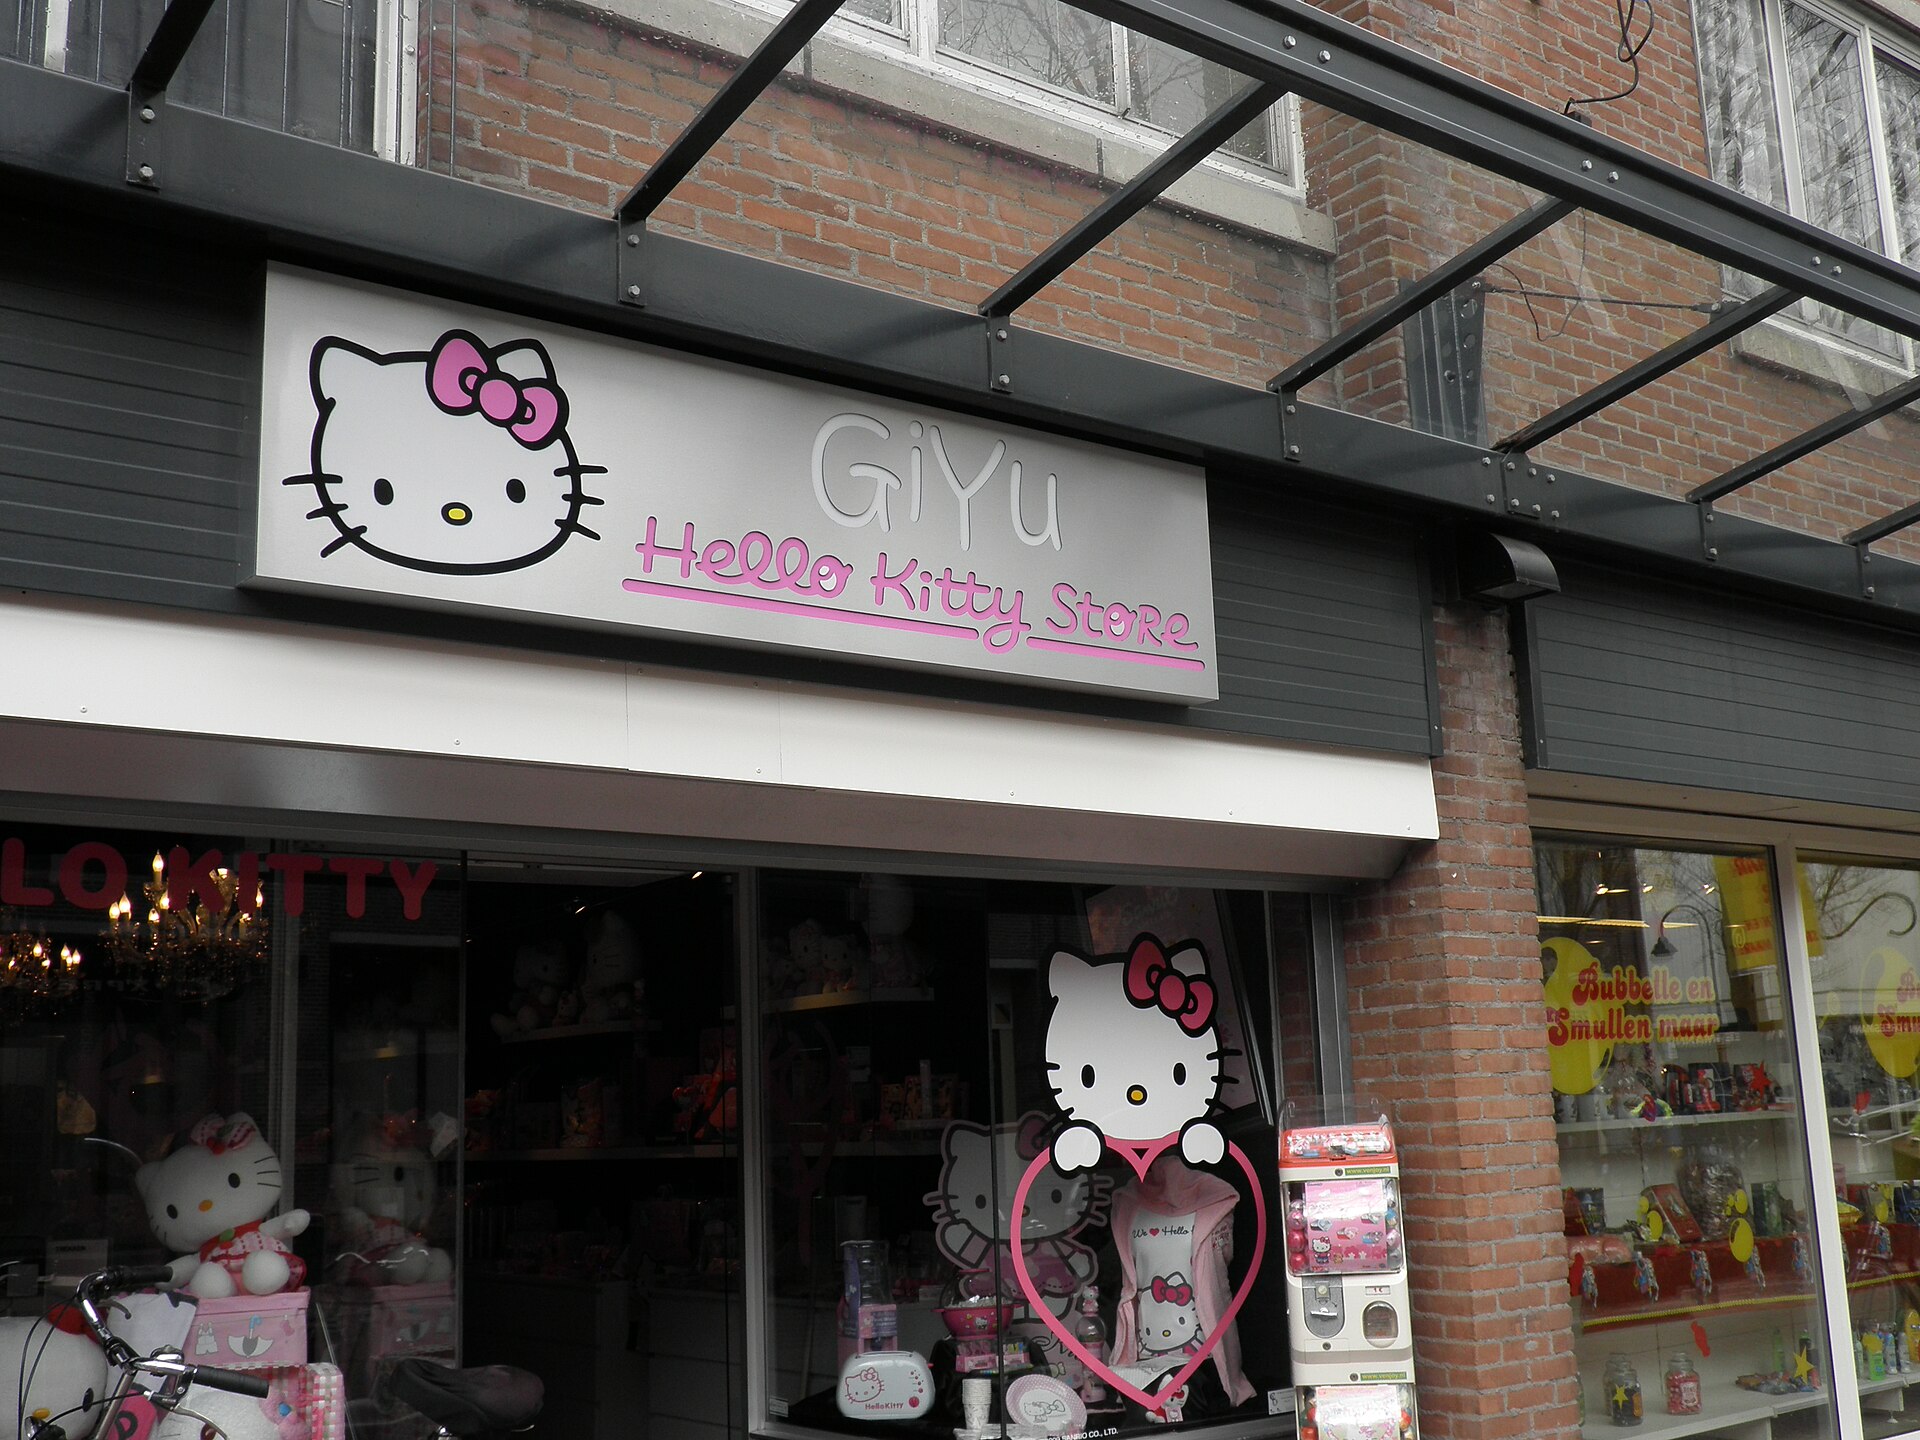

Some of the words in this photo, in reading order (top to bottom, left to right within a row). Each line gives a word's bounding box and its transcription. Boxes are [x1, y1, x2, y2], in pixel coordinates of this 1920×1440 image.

[811, 413, 1062, 551] GiYu
[635, 516, 853, 599] Hello
[870, 552, 1031, 654] Kitty
[1, 838, 127, 909] LO
[168, 847, 439, 920] KITTY
[1572, 961, 1681, 1006] Bubbelle
[1687, 977, 1714, 1000] en
[1549, 1007, 1650, 1046] Smullen
[1658, 1015, 1719, 1039] maar
[1132, 1229, 1147, 1238] We
[1162, 1225, 1189, 1236] Hello
